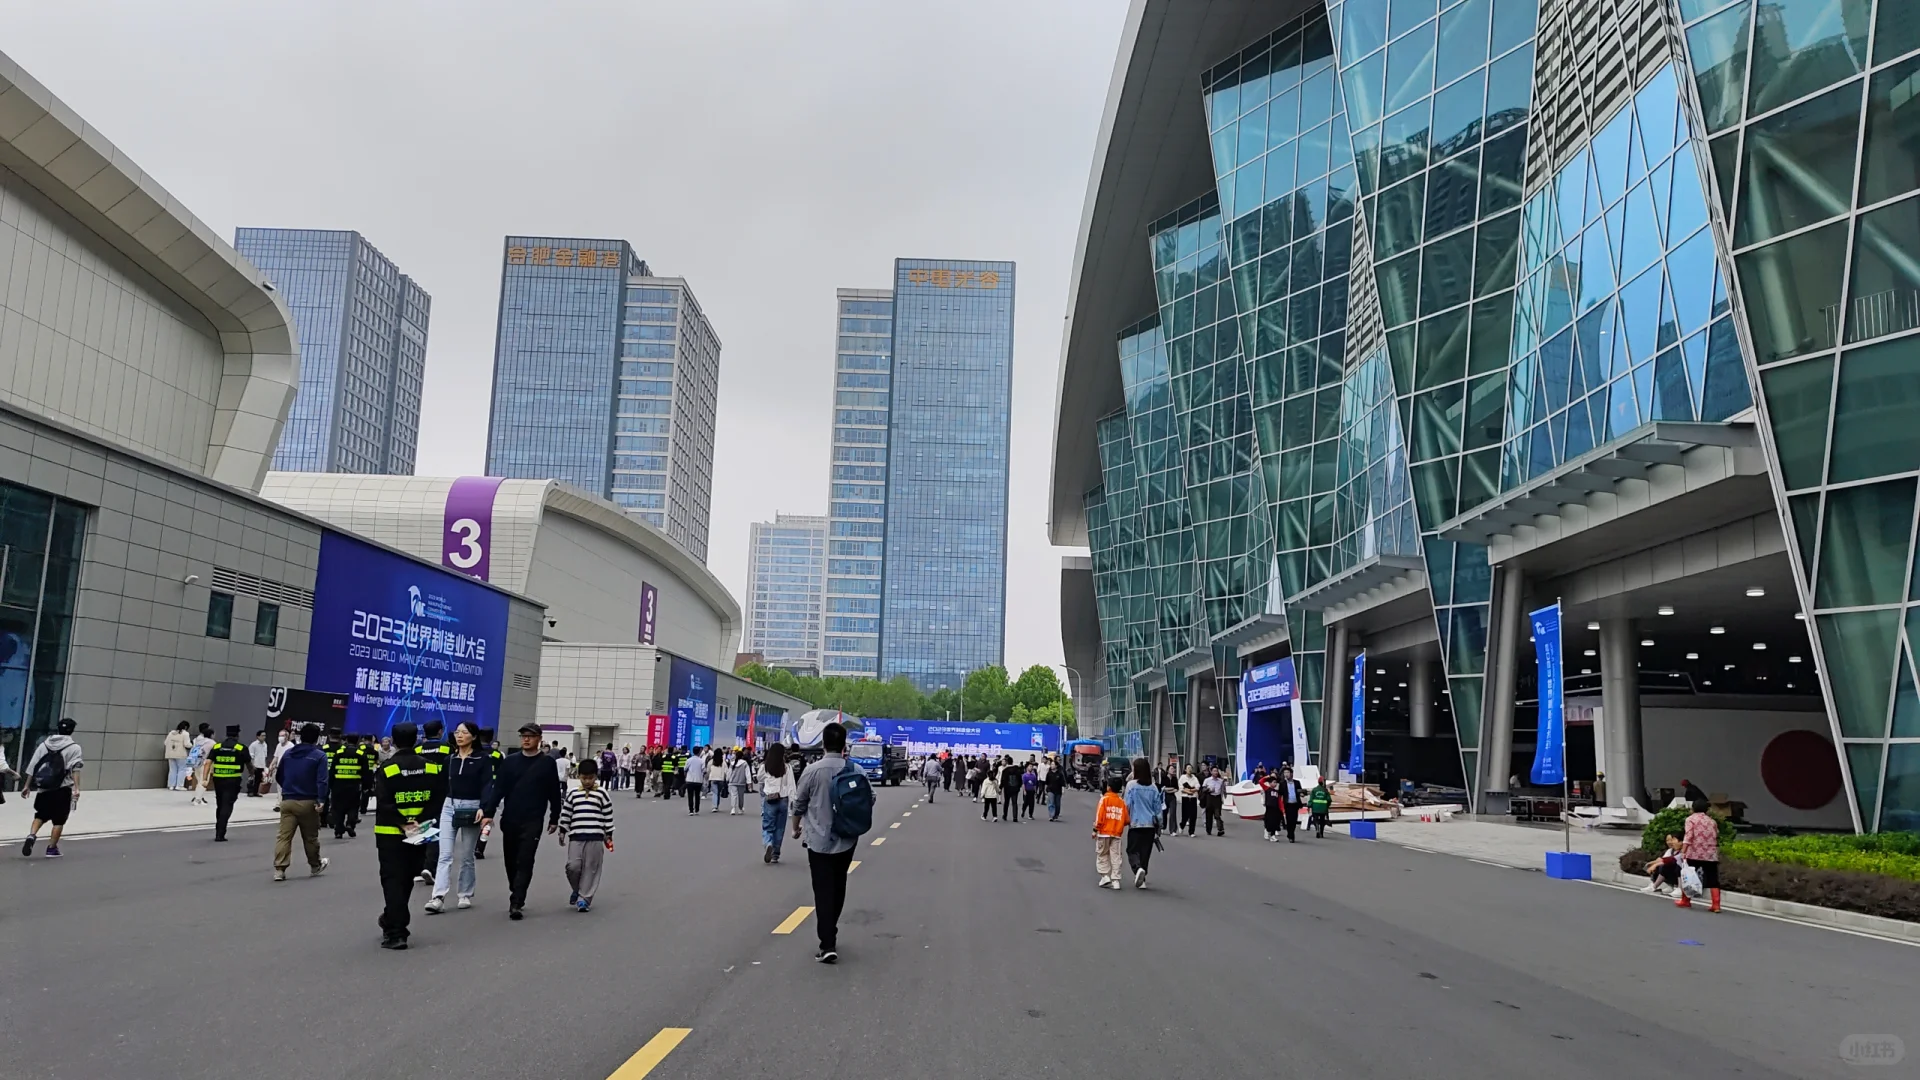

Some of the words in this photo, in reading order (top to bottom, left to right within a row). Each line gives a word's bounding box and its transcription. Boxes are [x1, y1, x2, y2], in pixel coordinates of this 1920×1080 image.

[508, 246, 620, 268] 合肥金融港
[909, 268, 999, 289] 中电光谷
[448, 518, 483, 569] 3
[646, 590, 653, 622] 3
[352, 609, 486, 662] 2023世界制造业大会
[350, 643, 370, 659] 2023
[372, 647, 396, 663] WORLD
[399, 652, 450, 672] MANUFACTURING
[451, 661, 483, 677] CONVENTION
[355, 667, 477, 702] 新能源汽车产业供应链展区
[353, 693, 366, 704] New
[366, 693, 384, 708] Energy
[384, 696, 402, 707] Vehicle
[402, 698, 420, 711] Industry
[420, 700, 436, 712] Supply
[447, 702, 466, 713] Exhibition
[394, 790, 431, 804] 恒安安保
[1105, 812, 1122, 821] WORK
[1106, 805, 1123, 815] WORK
